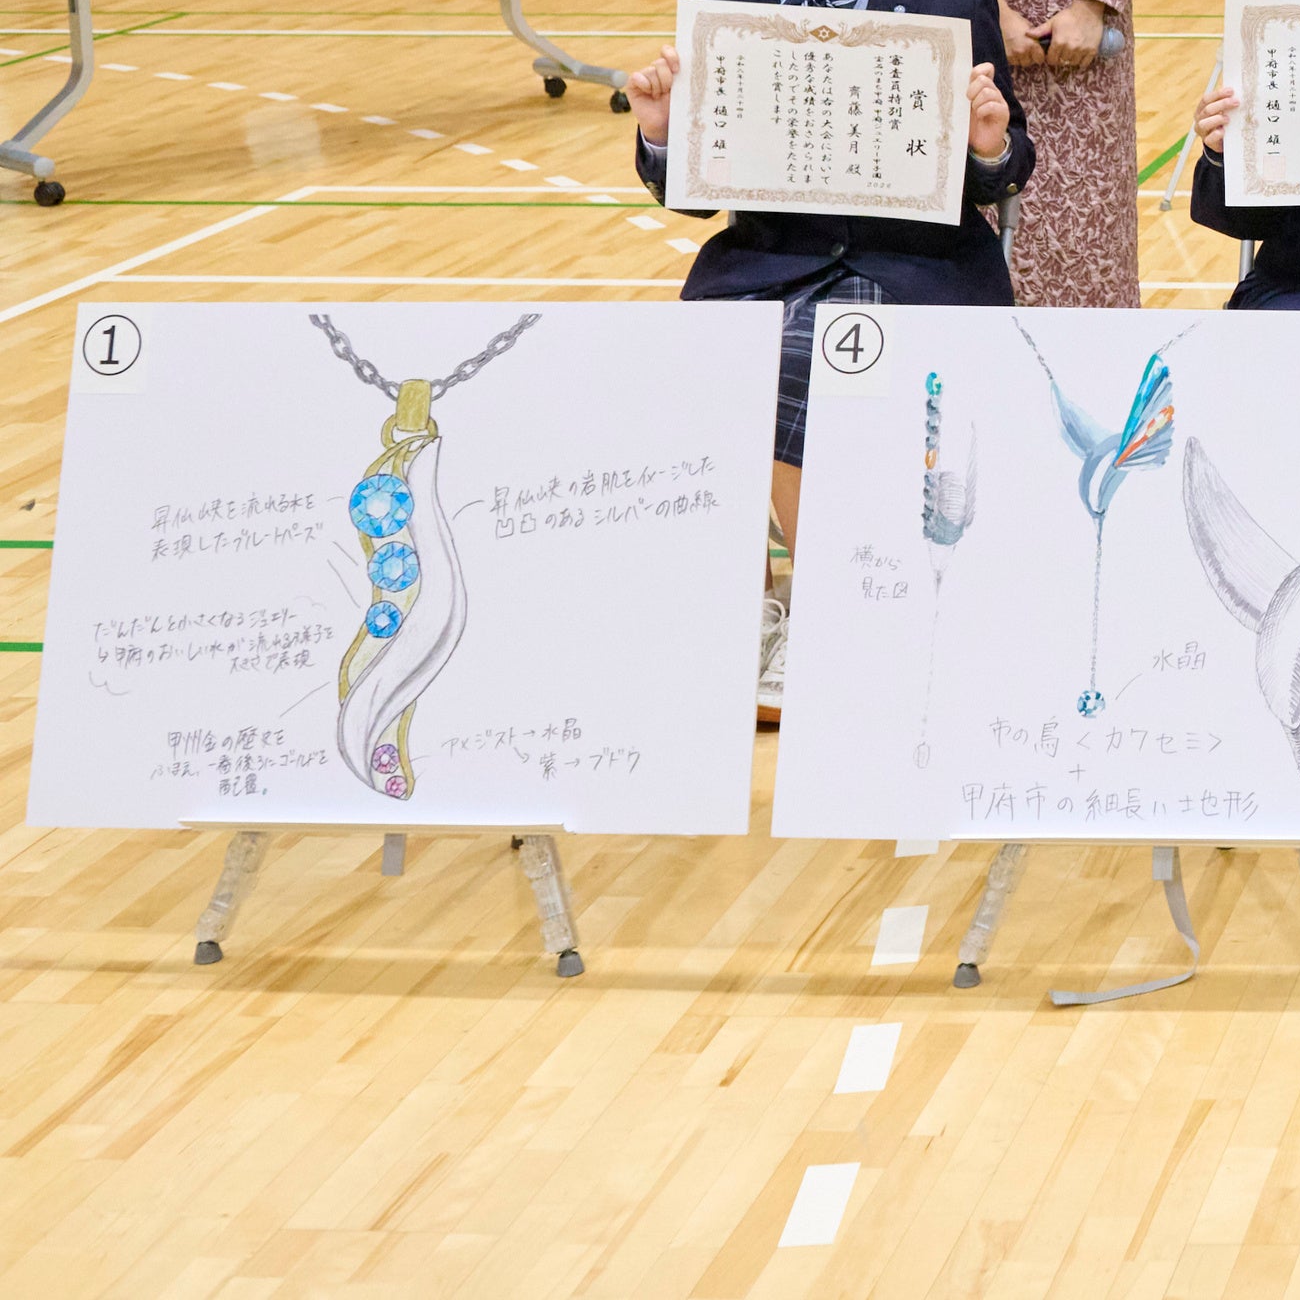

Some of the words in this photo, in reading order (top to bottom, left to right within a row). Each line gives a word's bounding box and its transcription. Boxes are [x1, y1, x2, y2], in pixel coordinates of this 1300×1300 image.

[714, 55, 727, 97] 甲府市長
[1266, 49, 1278, 90] 甲府市長
[888, 54, 903, 130] 審査員特別賞
[847, 124, 862, 154] 美月
[1152, 640, 1206, 673] 水晶
[541, 718, 582, 741] 水晶
[588, 746, 641, 774] ブドウ
